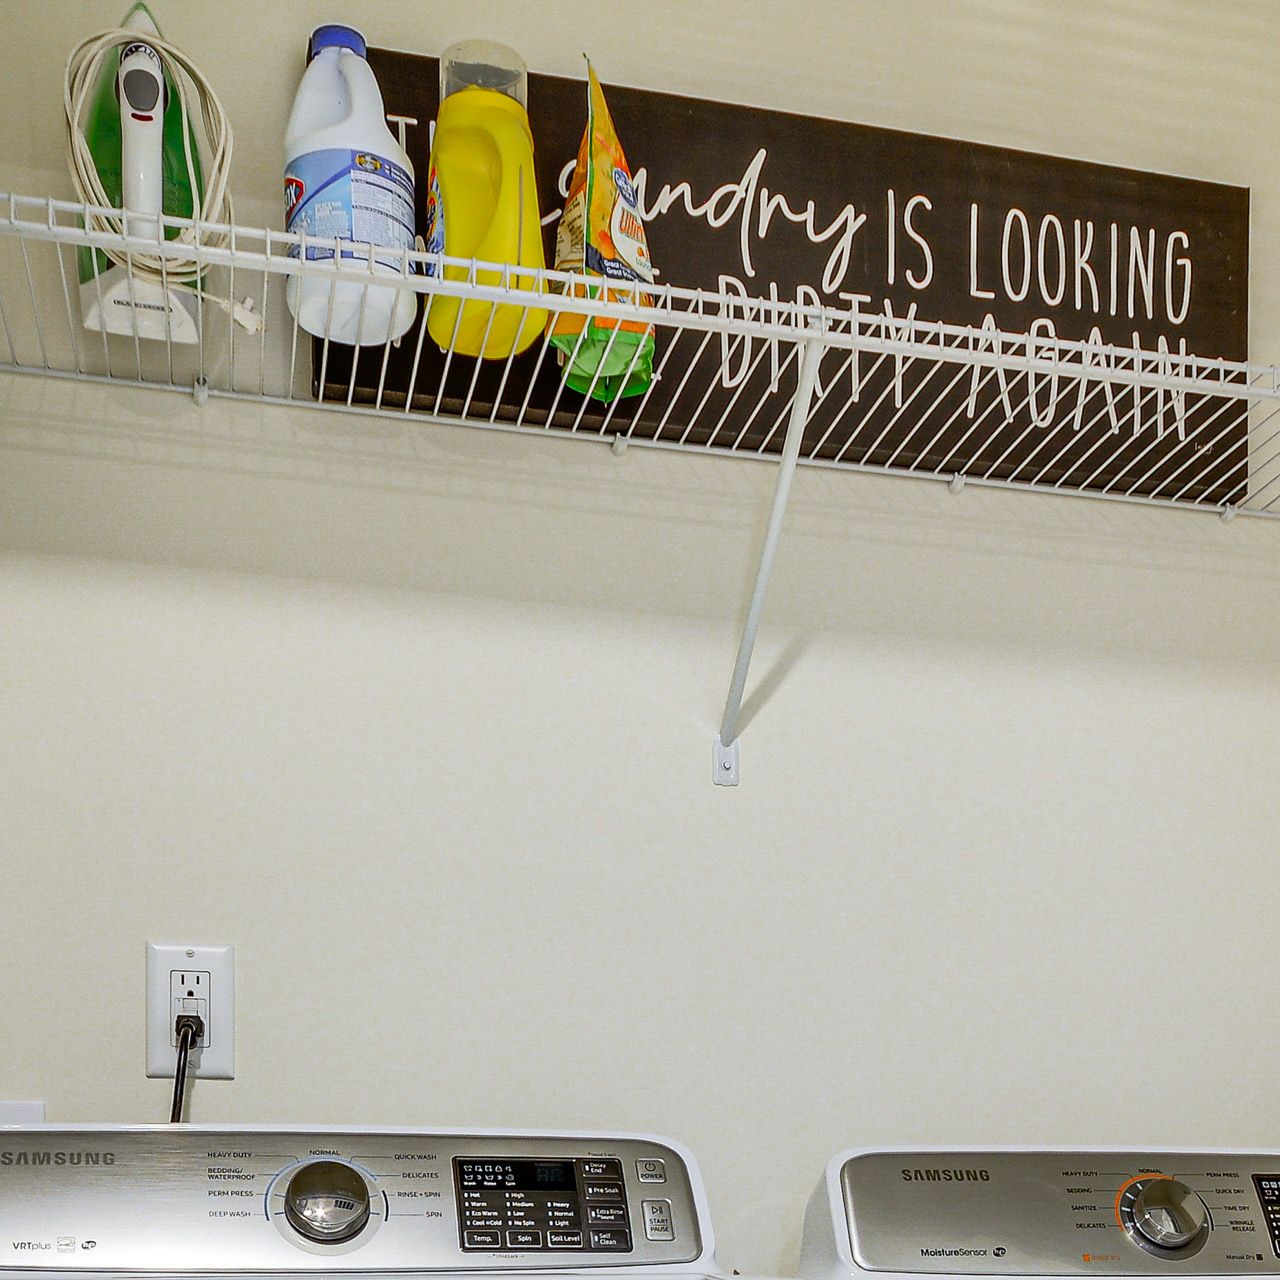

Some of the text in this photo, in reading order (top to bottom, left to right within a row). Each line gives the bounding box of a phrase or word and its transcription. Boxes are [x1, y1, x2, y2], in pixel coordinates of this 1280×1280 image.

[887, 188, 934, 290] IS
[970, 202, 1192, 325] LOOKING
[718, 274, 918, 409] DIRTY
[966, 313, 1187, 442] AGAIN
[0, 1151, 116, 1166] SAMSUNG
[901, 1169, 990, 1181] SAMSUNG
[517, 1235, 532, 1243] Spin
[12, 1241, 52, 1251] VRTplus
[920, 1248, 987, 1257] MoistureSensor
